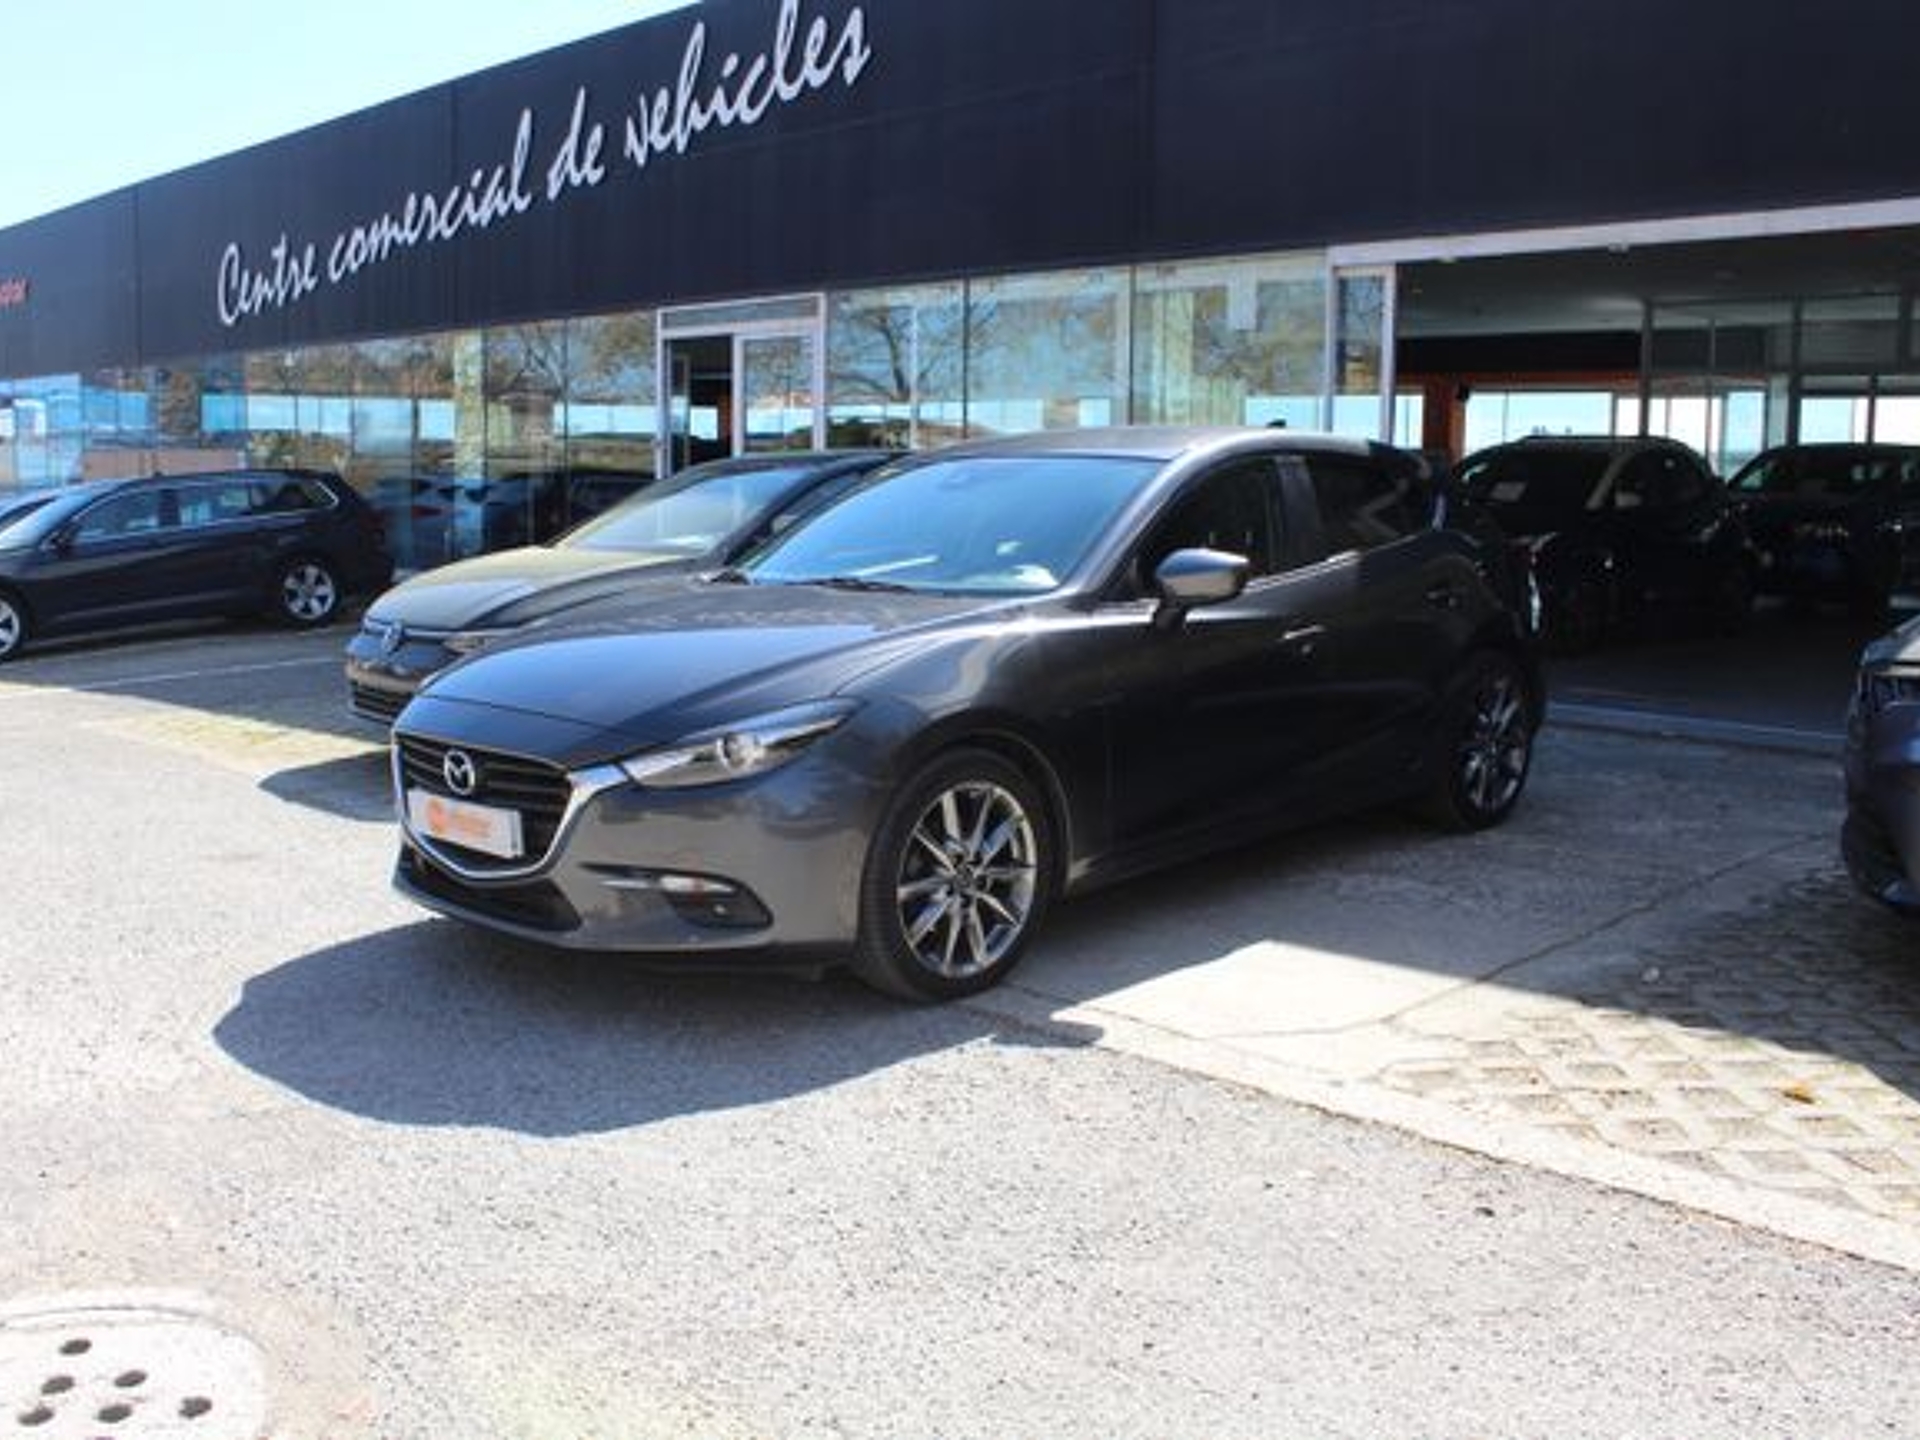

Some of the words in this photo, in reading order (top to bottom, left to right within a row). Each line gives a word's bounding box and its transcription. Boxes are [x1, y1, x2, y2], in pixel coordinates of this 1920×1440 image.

[217, 233, 318, 326] Centre
[327, 108, 532, 282] comercial
[547, 86, 605, 200] de
[624, 0, 871, 167] vehicles
